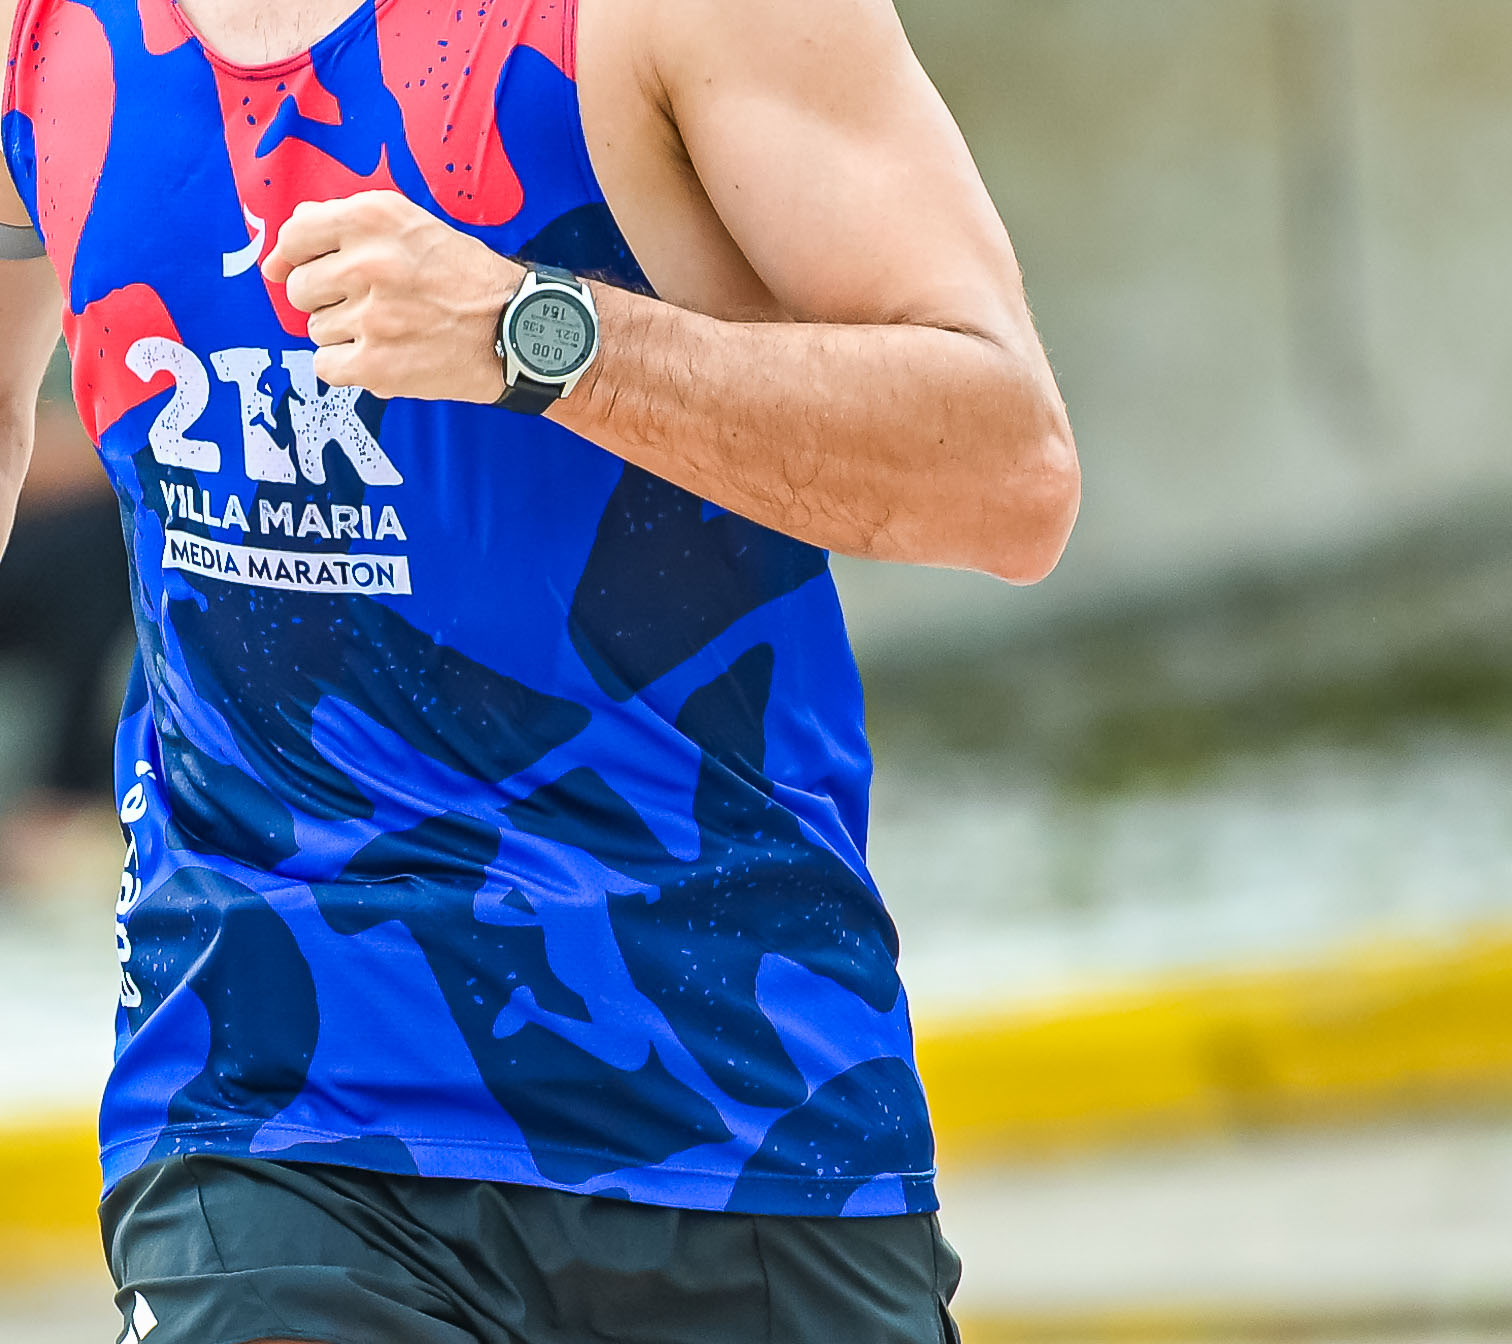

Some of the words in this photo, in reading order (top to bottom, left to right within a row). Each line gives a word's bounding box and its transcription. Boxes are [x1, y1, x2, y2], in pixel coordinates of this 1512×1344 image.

[125, 336, 404, 485] 21K
[160, 479, 250, 532] VILLA
[258, 498, 407, 541] MARIA
[170, 538, 241, 576] MEDIA
[248, 555, 395, 589] MARATON
